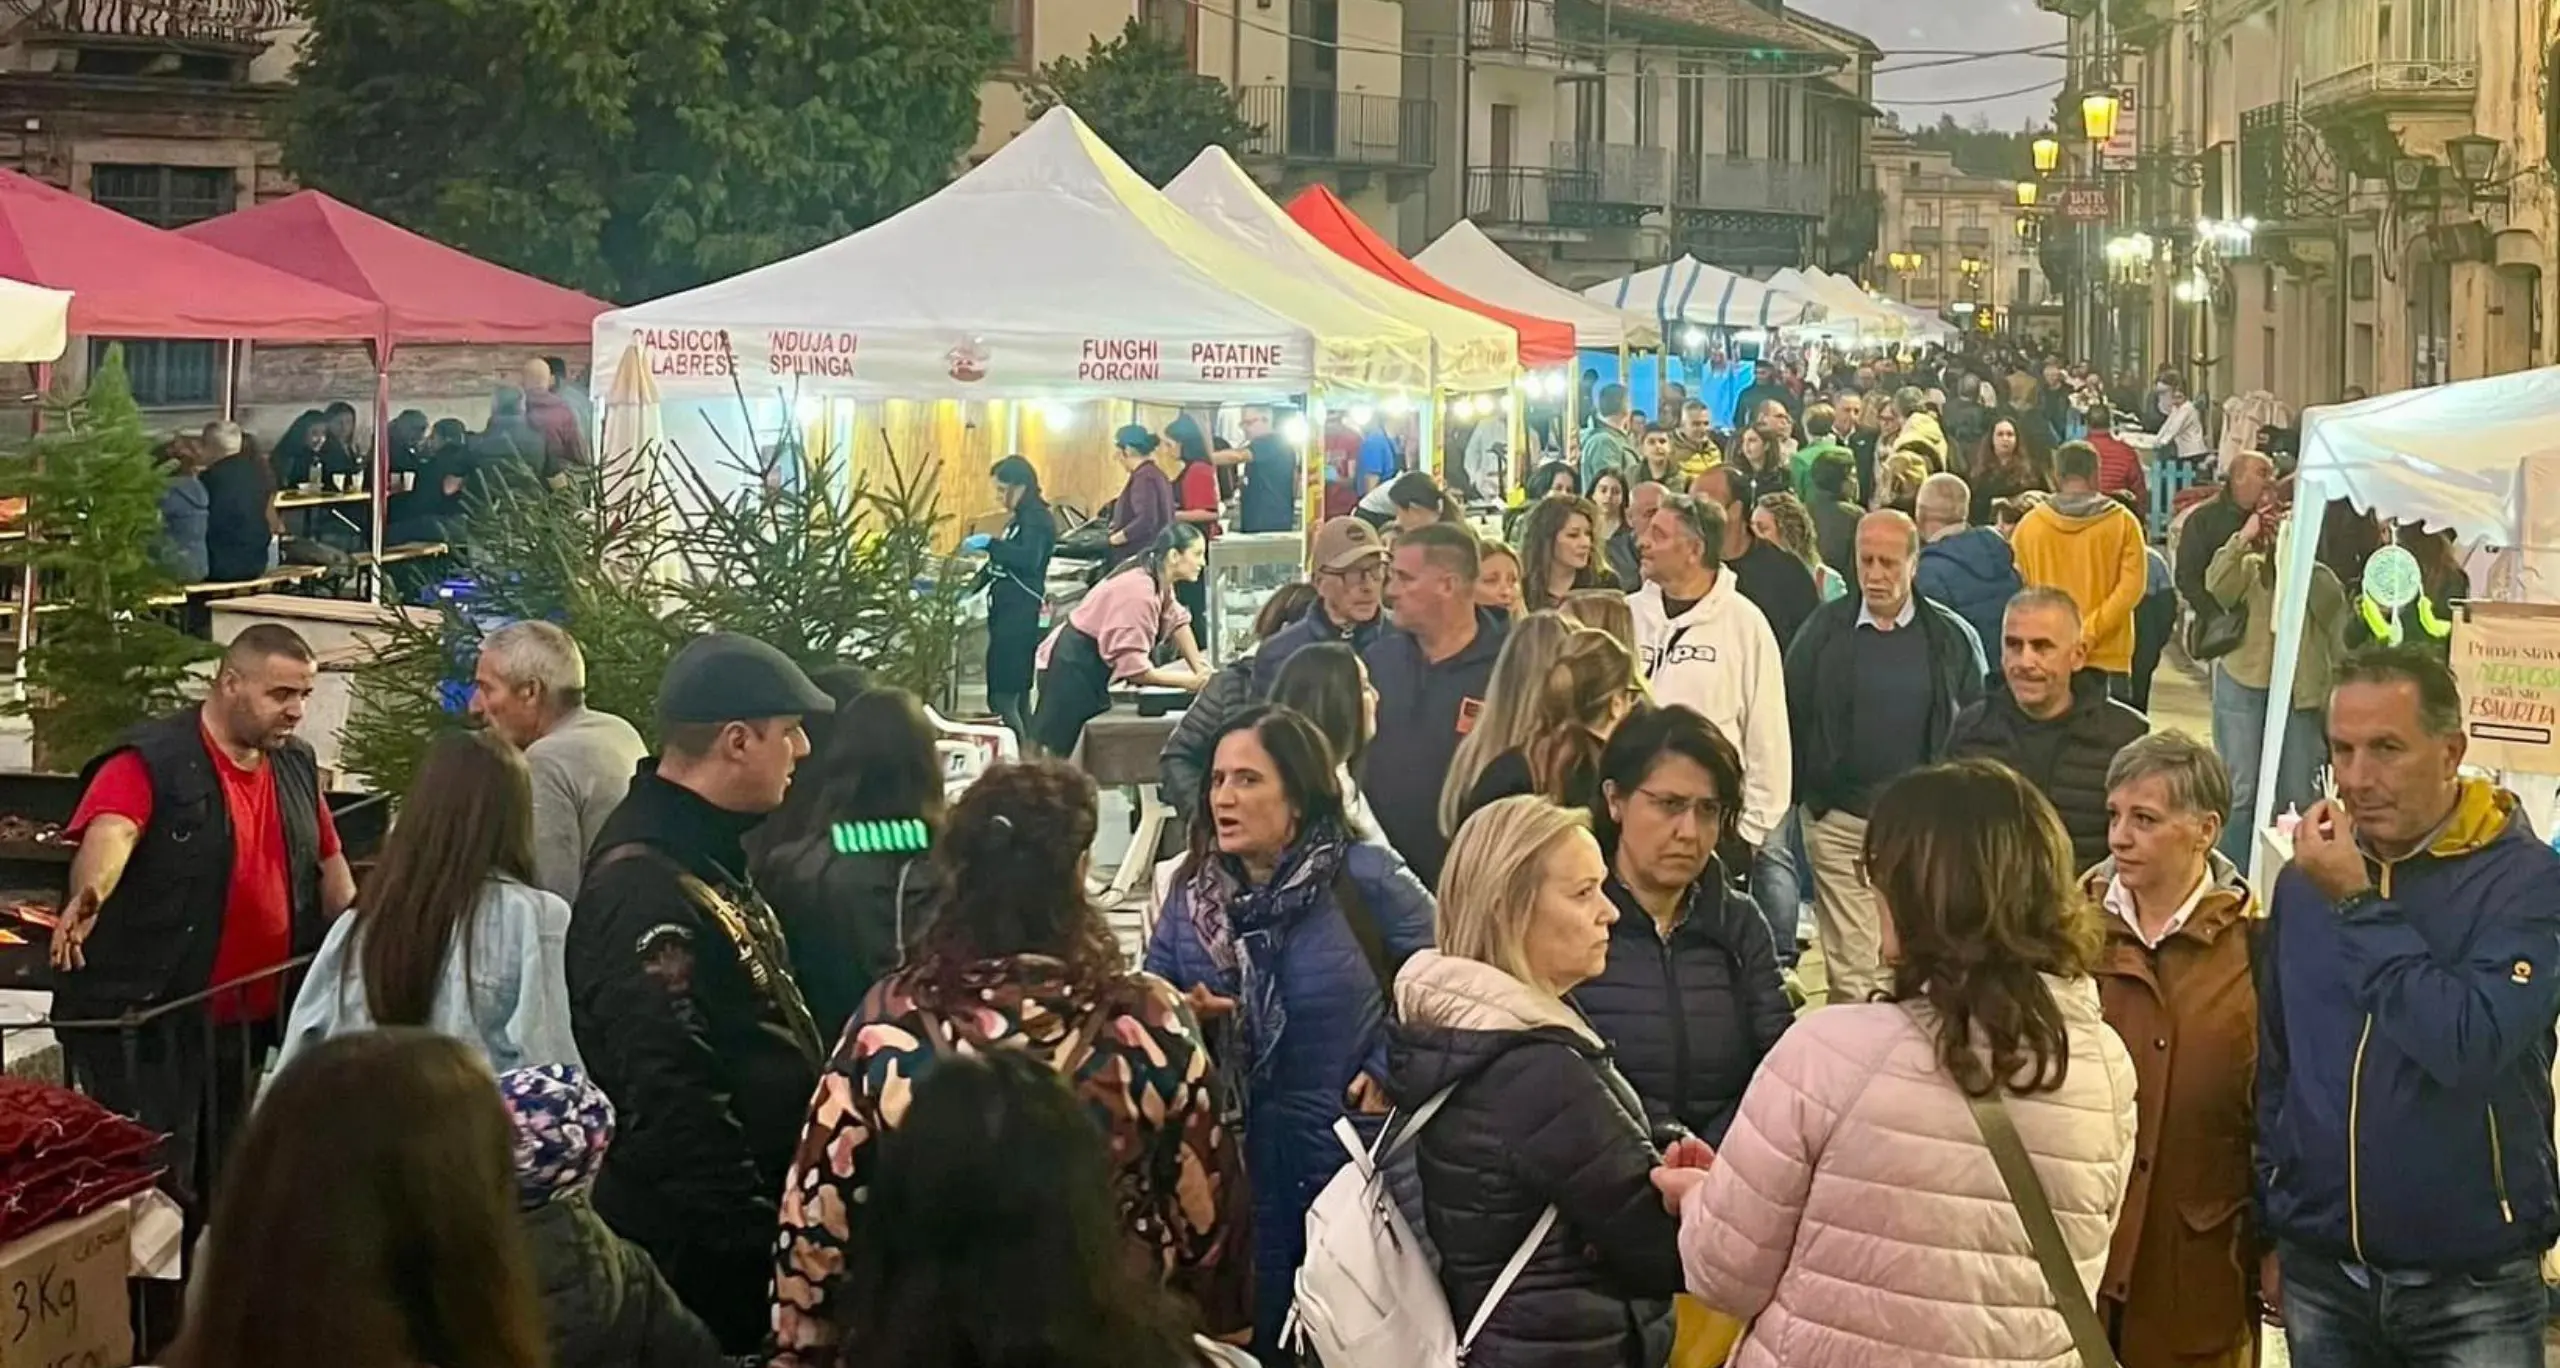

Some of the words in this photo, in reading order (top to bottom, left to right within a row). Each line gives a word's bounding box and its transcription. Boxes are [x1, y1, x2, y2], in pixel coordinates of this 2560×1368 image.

[839, 331, 858, 354] DI
[1083, 339, 1158, 361] FUNGHI
[1191, 342, 1283, 366] PATATINE
[651, 353, 739, 376] LABRESE
[770, 355, 854, 378] SPILINGA
[1078, 362, 1160, 382] PORCINI
[2522, 642, 2560, 662] stav
[2469, 696, 2555, 726] ESAURITA
